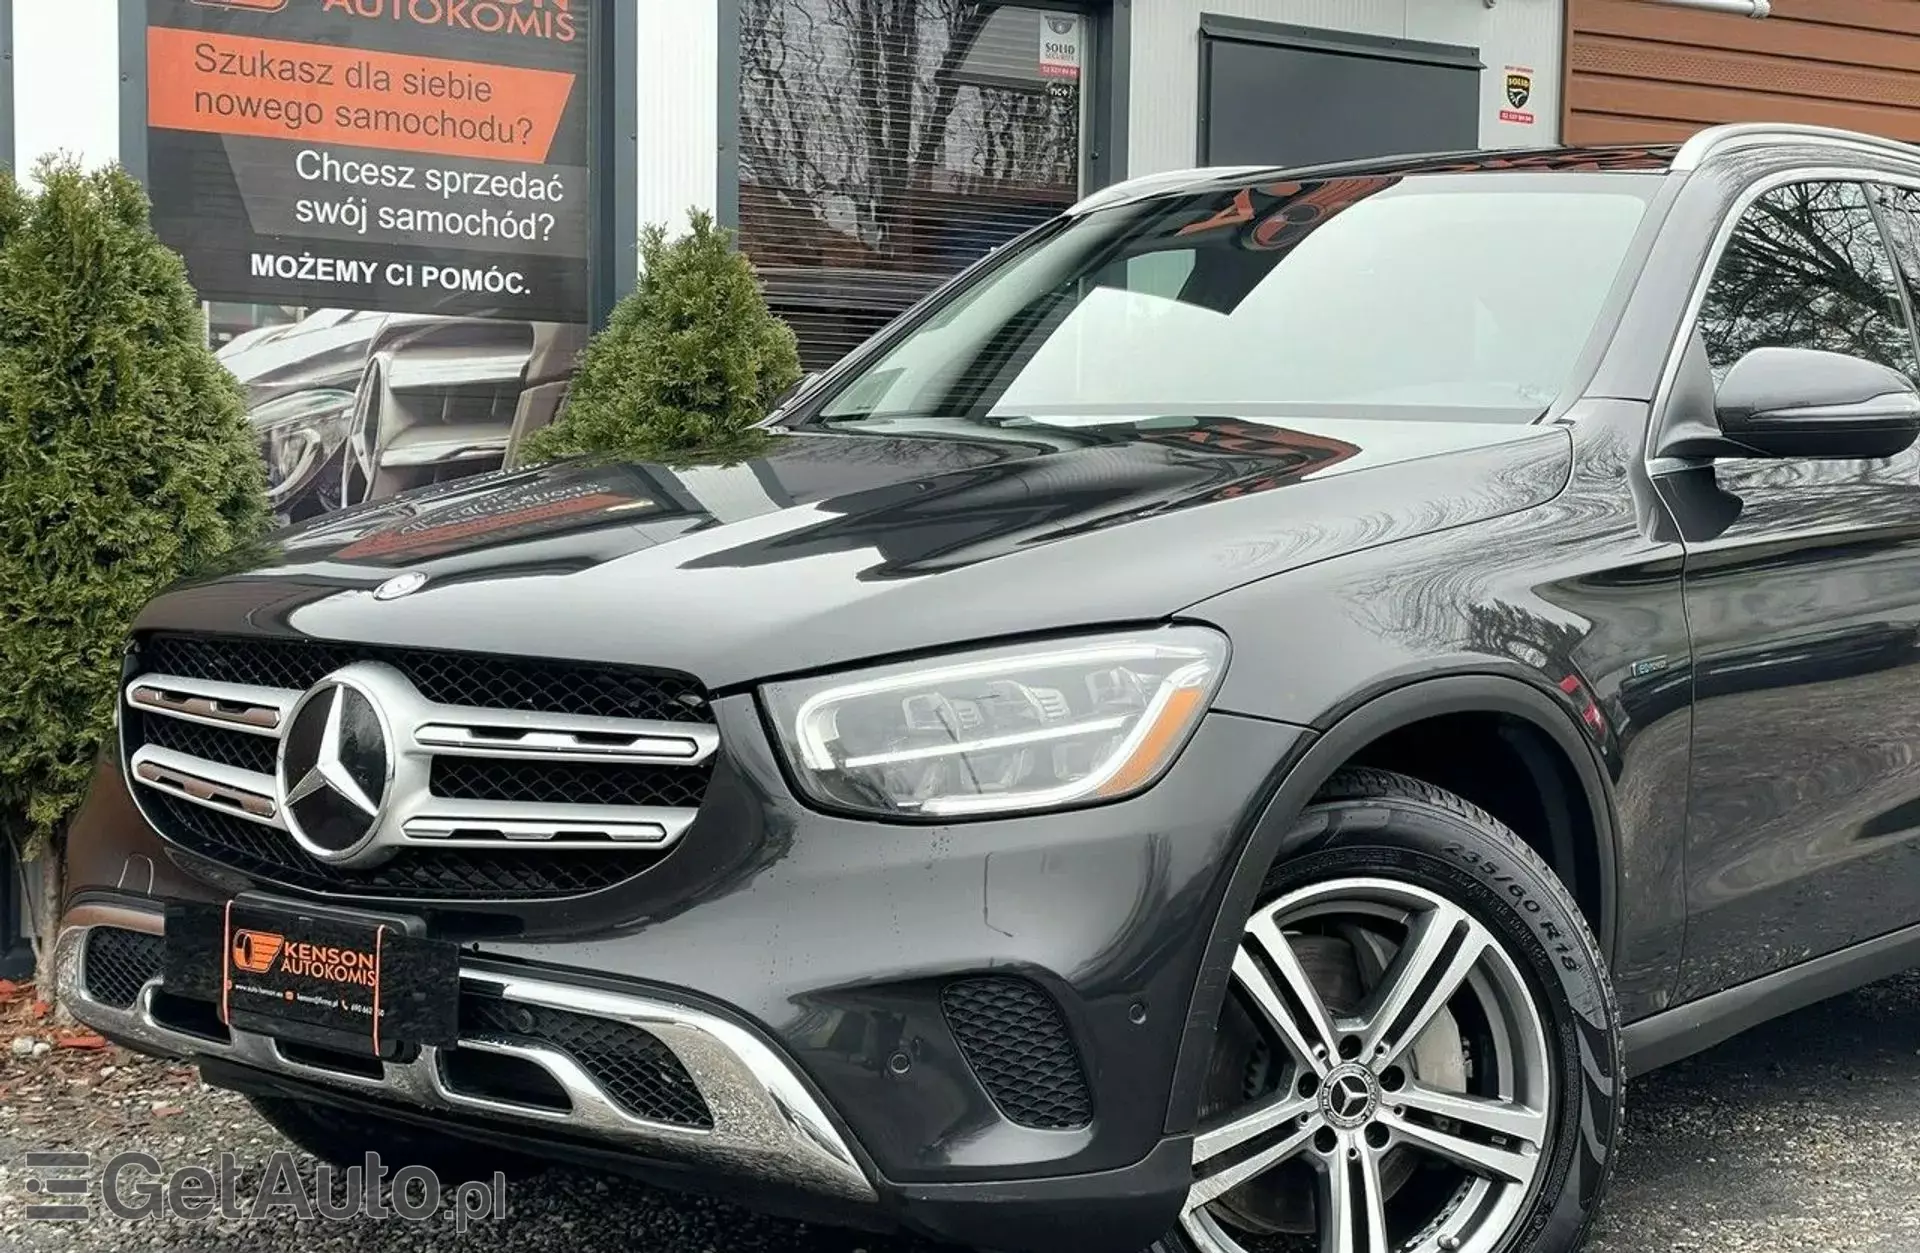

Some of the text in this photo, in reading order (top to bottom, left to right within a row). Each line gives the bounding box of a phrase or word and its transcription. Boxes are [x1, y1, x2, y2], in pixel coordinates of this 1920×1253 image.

[1045, 43, 1075, 54] SOLID
[194, 43, 492, 102] Szukasz dla siebie
[195, 90, 533, 145] nowego samochodu?
[295, 149, 564, 202] Chcesz sprzedać
[295, 196, 555, 242] swój samochód?
[250, 251, 531, 295] MOŻEMY CI POMÓC.
[281, 957, 377, 987] AUTOKOMIS
[284, 941, 374, 969] KENSON
